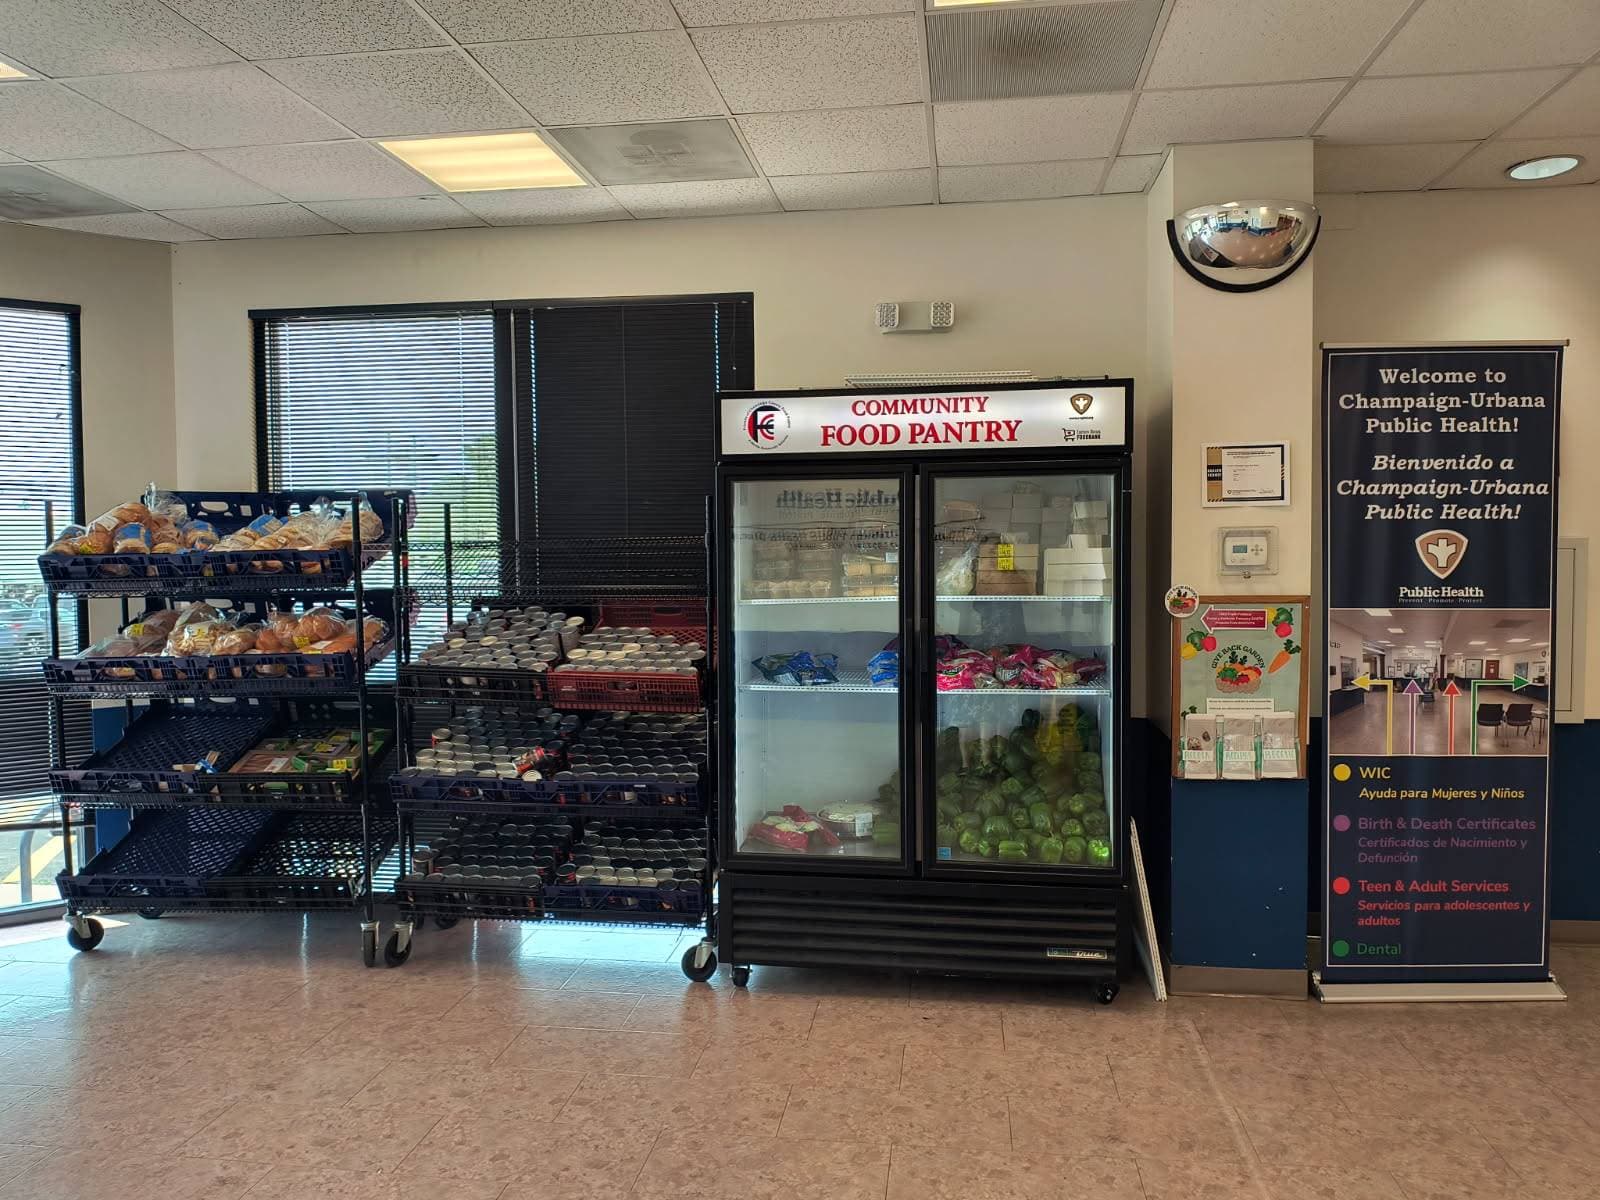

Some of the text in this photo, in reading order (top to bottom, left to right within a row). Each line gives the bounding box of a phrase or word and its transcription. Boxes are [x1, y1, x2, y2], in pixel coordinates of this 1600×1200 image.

[1379, 368, 1507, 384] Welcome to
[851, 396, 990, 416] COMMUNITY
[1338, 392, 1546, 412] Champaign-Urbana
[1365, 417, 1519, 433] Public Health!
[820, 423, 901, 447] FOOD
[908, 420, 1023, 445] PANTRY
[1372, 454, 1514, 471] Bienvenido a
[1336, 478, 1550, 499] Champaign-Urbana
[1364, 504, 1522, 520] Public Health!
[1398, 586, 1485, 598] Public Health
[1211, 645, 1265, 669] GIVE BACK GARDEN
[1359, 766, 1392, 779] WIC
[1359, 788, 1525, 801] Ayuda para Mujeres y Niños
[1358, 817, 1537, 830] Birth & Death Certificates
[1358, 838, 1527, 850] Certificados de Nacimiento y
[1358, 852, 1418, 863] Defunción
[1358, 879, 1509, 893] Teen & Adult Services
[1358, 900, 1531, 912] Servicios para adolescentes y
[1358, 916, 1401, 926] adultos
[1357, 943, 1401, 955] Dental
